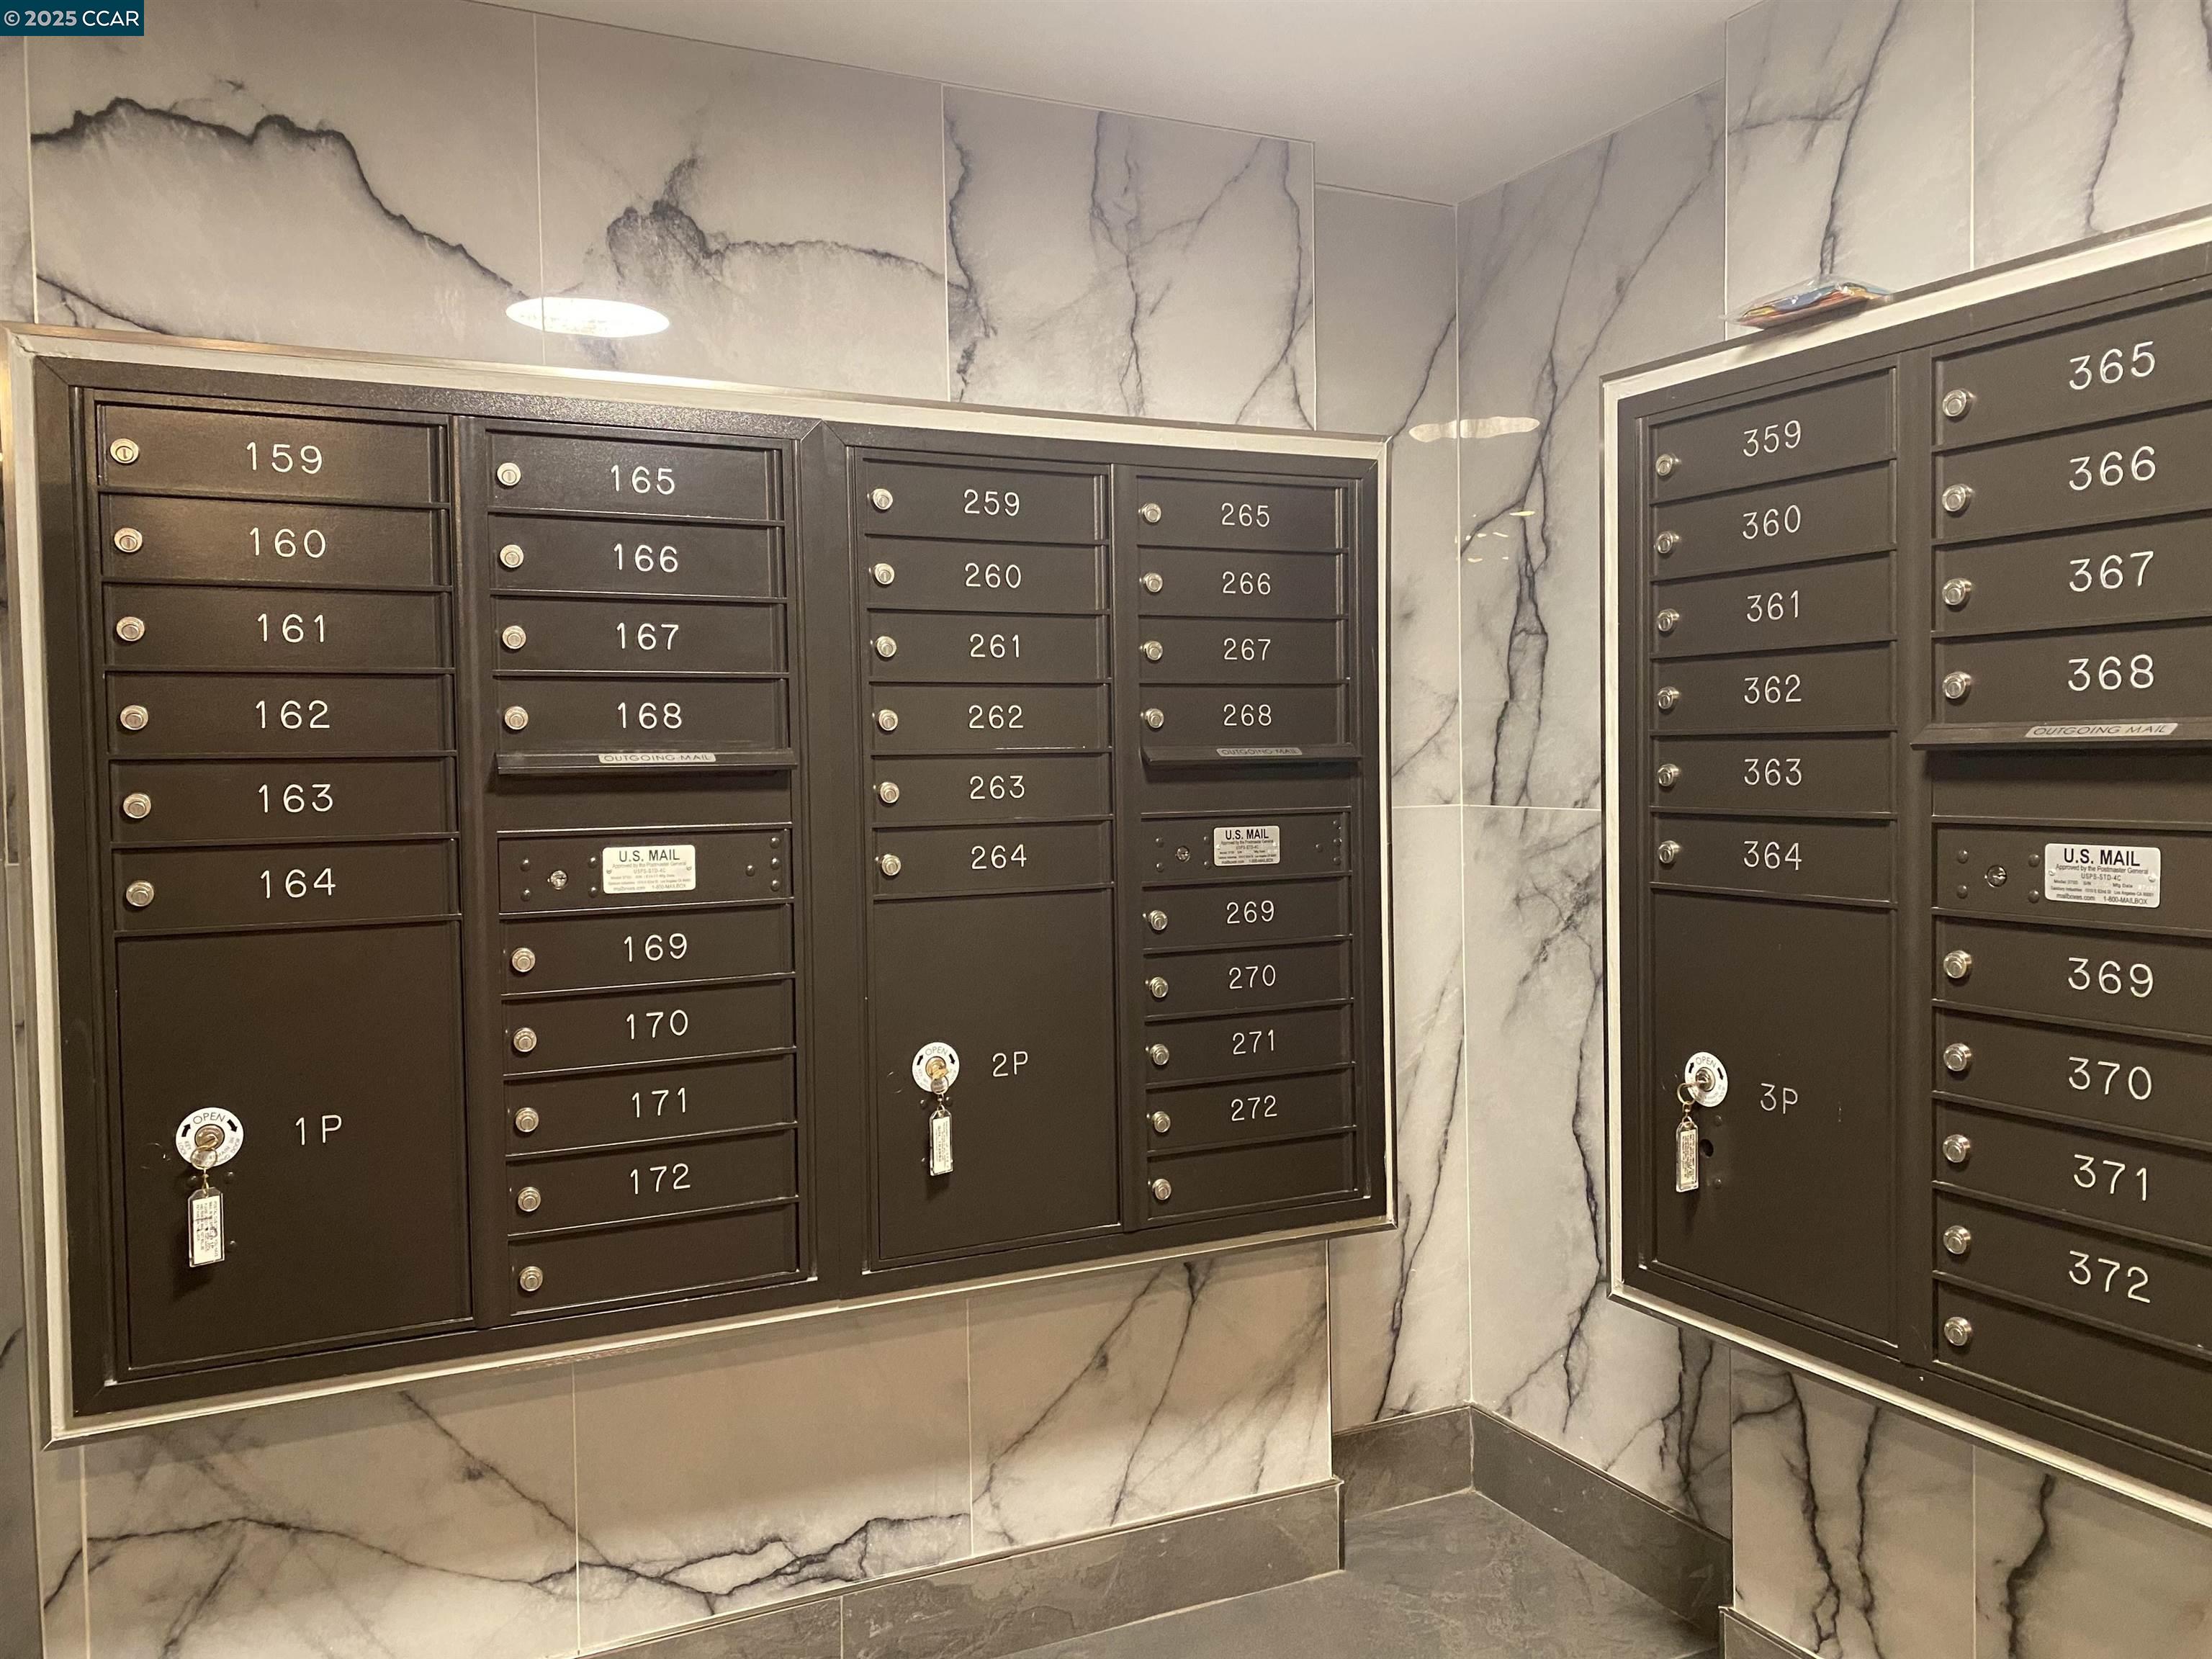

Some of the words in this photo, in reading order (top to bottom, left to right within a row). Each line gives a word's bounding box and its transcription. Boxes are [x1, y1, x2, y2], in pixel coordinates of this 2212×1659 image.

[2069, 341, 2154, 390] 365
[1743, 421, 1801, 457] 359
[247, 442, 322, 474] 159
[2069, 446, 2155, 490] 366
[611, 465, 675, 495] 165
[964, 489, 1019, 516] 259
[1222, 503, 1269, 527] 265
[1743, 505, 1800, 539] 360
[250, 528, 325, 558] 160
[614, 544, 678, 572] 166
[2069, 551, 2153, 592] 367
[966, 563, 1021, 588] 260
[1223, 572, 1270, 595] 266
[1747, 590, 1798, 621] 361
[258, 613, 323, 642] 161
[617, 623, 678, 649] 167
[970, 634, 1019, 657] 261
[1224, 638, 1270, 660] 267
[2068, 655, 2154, 691] 368
[1745, 675, 1802, 703] 362
[256, 700, 330, 729] 162
[618, 703, 682, 729] 168
[969, 705, 1023, 728] 262
[1224, 704, 1271, 726] 268
[2033, 726, 2121, 735] OUTGOING
[2125, 725, 2167, 734] MAIL
[1745, 759, 1802, 786] 363
[258, 784, 333, 812] 163
[970, 775, 1024, 799] 263
[1225, 830, 1244, 840] U.S.
[1246, 828, 1269, 840] MAIL
[619, 850, 644, 863] U.S.
[649, 848, 680, 862] MAIL
[971, 845, 1027, 869] 264
[1744, 841, 1802, 870] 364
[2064, 848, 2094, 864] U.S.
[2100, 849, 2140, 866] MAIL
[261, 868, 336, 899] 164
[2081, 873, 2121, 881] USPS-STD-4C
[1227, 901, 1274, 923] 269
[624, 933, 687, 962] 169
[1229, 965, 1275, 989] 270
[2069, 958, 2153, 997] 369
[626, 1010, 688, 1039] 170
[925, 1046, 948, 1056] OPEN
[1233, 1030, 1273, 1054] 271
[993, 1051, 1028, 1076] 2P
[1695, 1056, 1716, 1069] OPEN
[2069, 1057, 2152, 1100] 370
[632, 1088, 685, 1118] 171
[1231, 1095, 1277, 1121] 272
[1760, 1082, 1799, 1115] 3P
[193, 1112, 225, 1124] OPEN
[296, 1115, 341, 1145] 1P
[631, 1164, 691, 1194] 172
[2074, 1154, 2146, 1200] 371
[2069, 1251, 2150, 1303] 372
